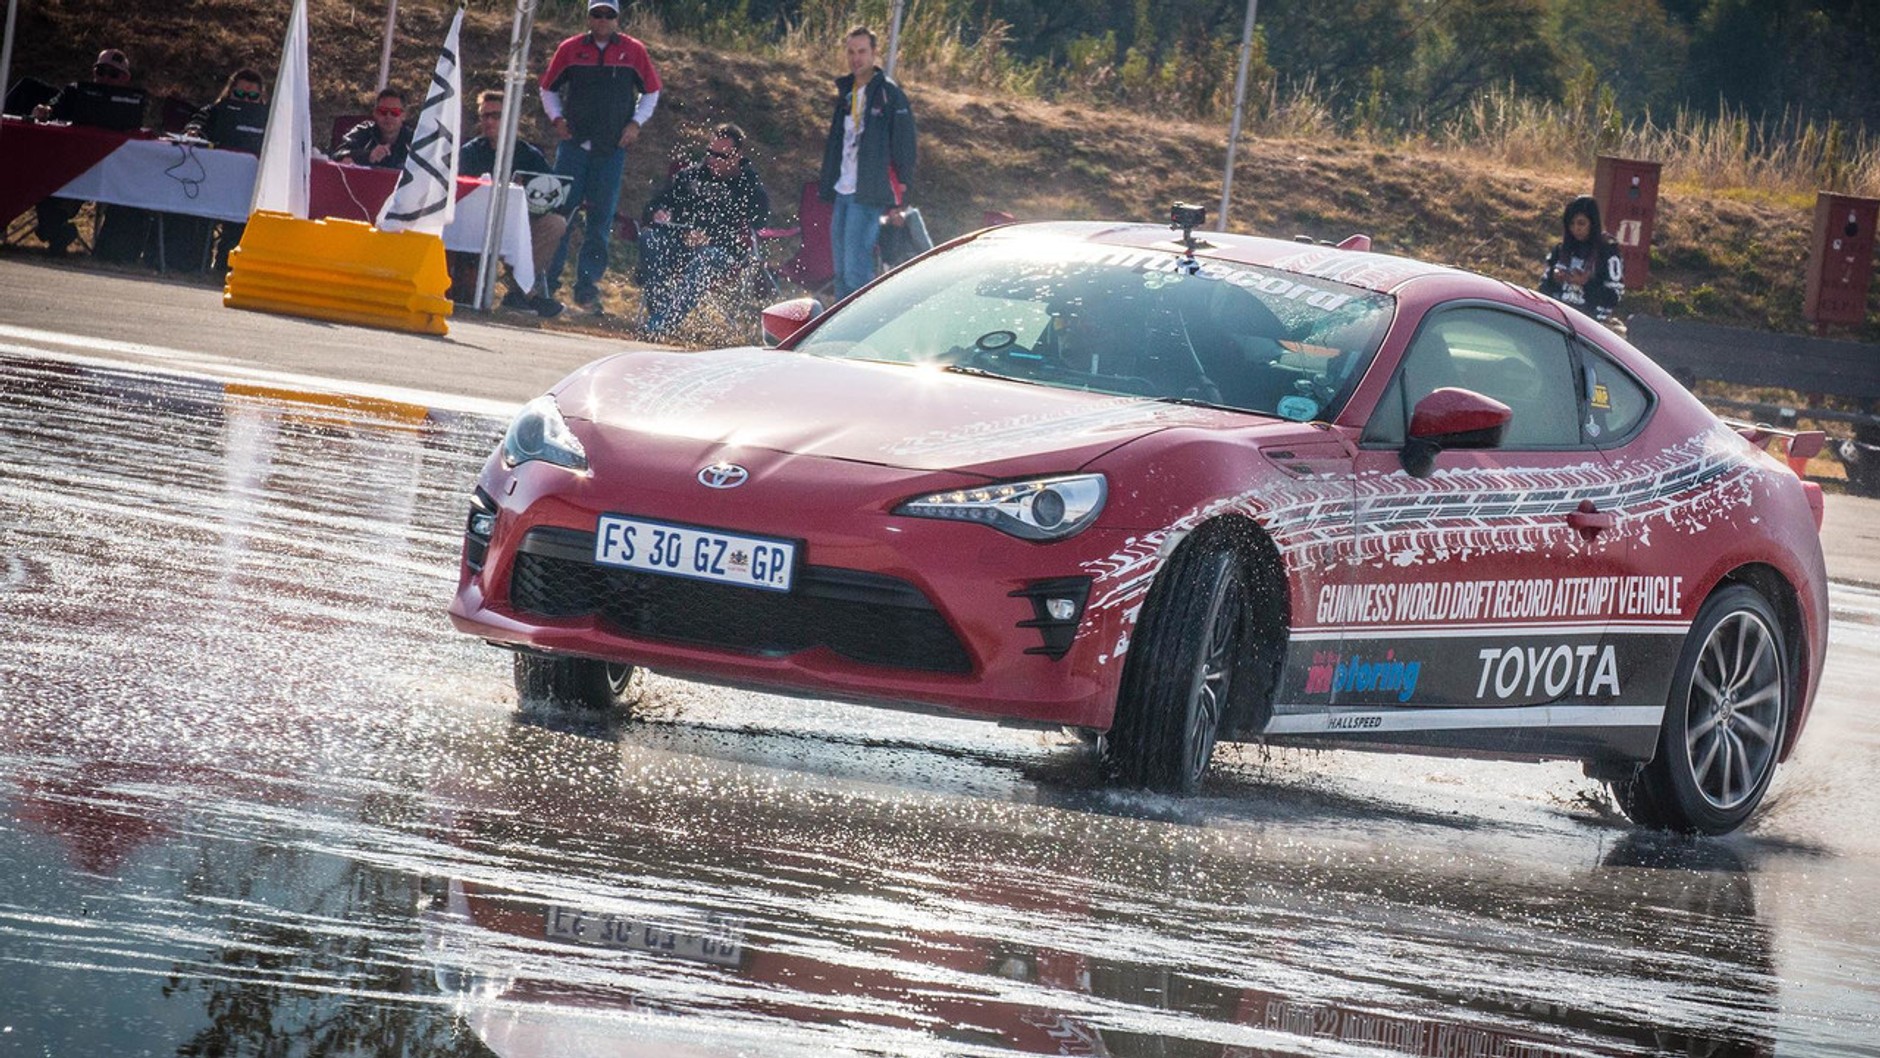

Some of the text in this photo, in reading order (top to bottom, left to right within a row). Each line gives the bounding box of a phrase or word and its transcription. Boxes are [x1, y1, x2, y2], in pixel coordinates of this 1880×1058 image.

[603, 523, 785, 582] FS 30 GZ GP
[1316, 576, 1683, 623] GUINNESS WORLD DRIFT RECORD ATTEMPT VEHICLE
[1476, 644, 1620, 699] TOYOTA
[1328, 717, 1382, 728] HALLSPEED
